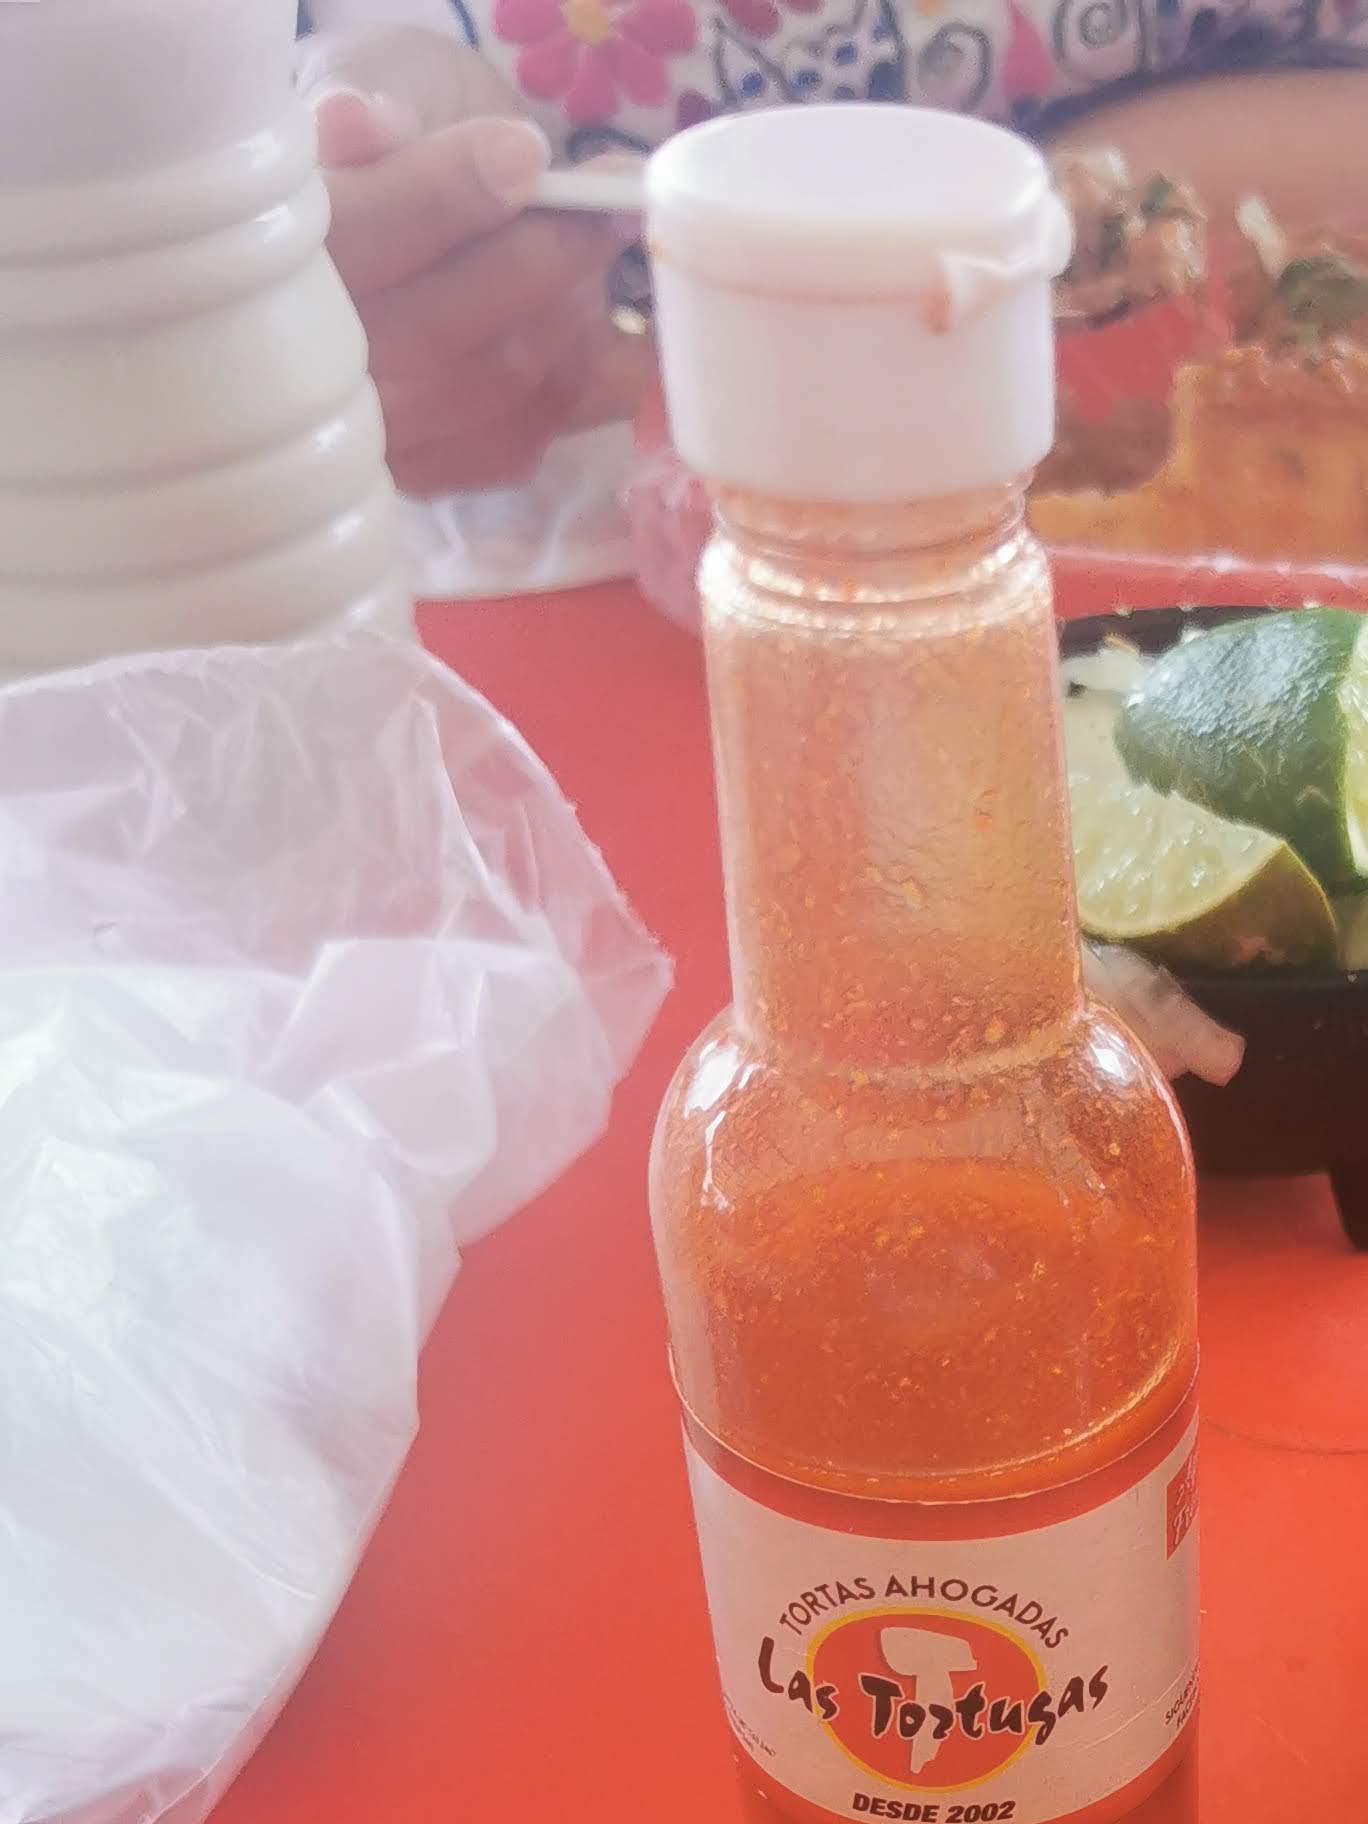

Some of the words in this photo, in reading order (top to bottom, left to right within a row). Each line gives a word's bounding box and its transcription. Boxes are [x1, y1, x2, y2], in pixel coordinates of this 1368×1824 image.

[779, 1576, 876, 1636] TORTAS
[885, 1574, 1069, 1649] AHOGADAS
[758, 1635, 840, 1720] Las
[859, 1664, 1109, 1746] Tortugas
[852, 1792, 940, 1824] DESDE
[944, 1800, 1016, 1824] 2002
